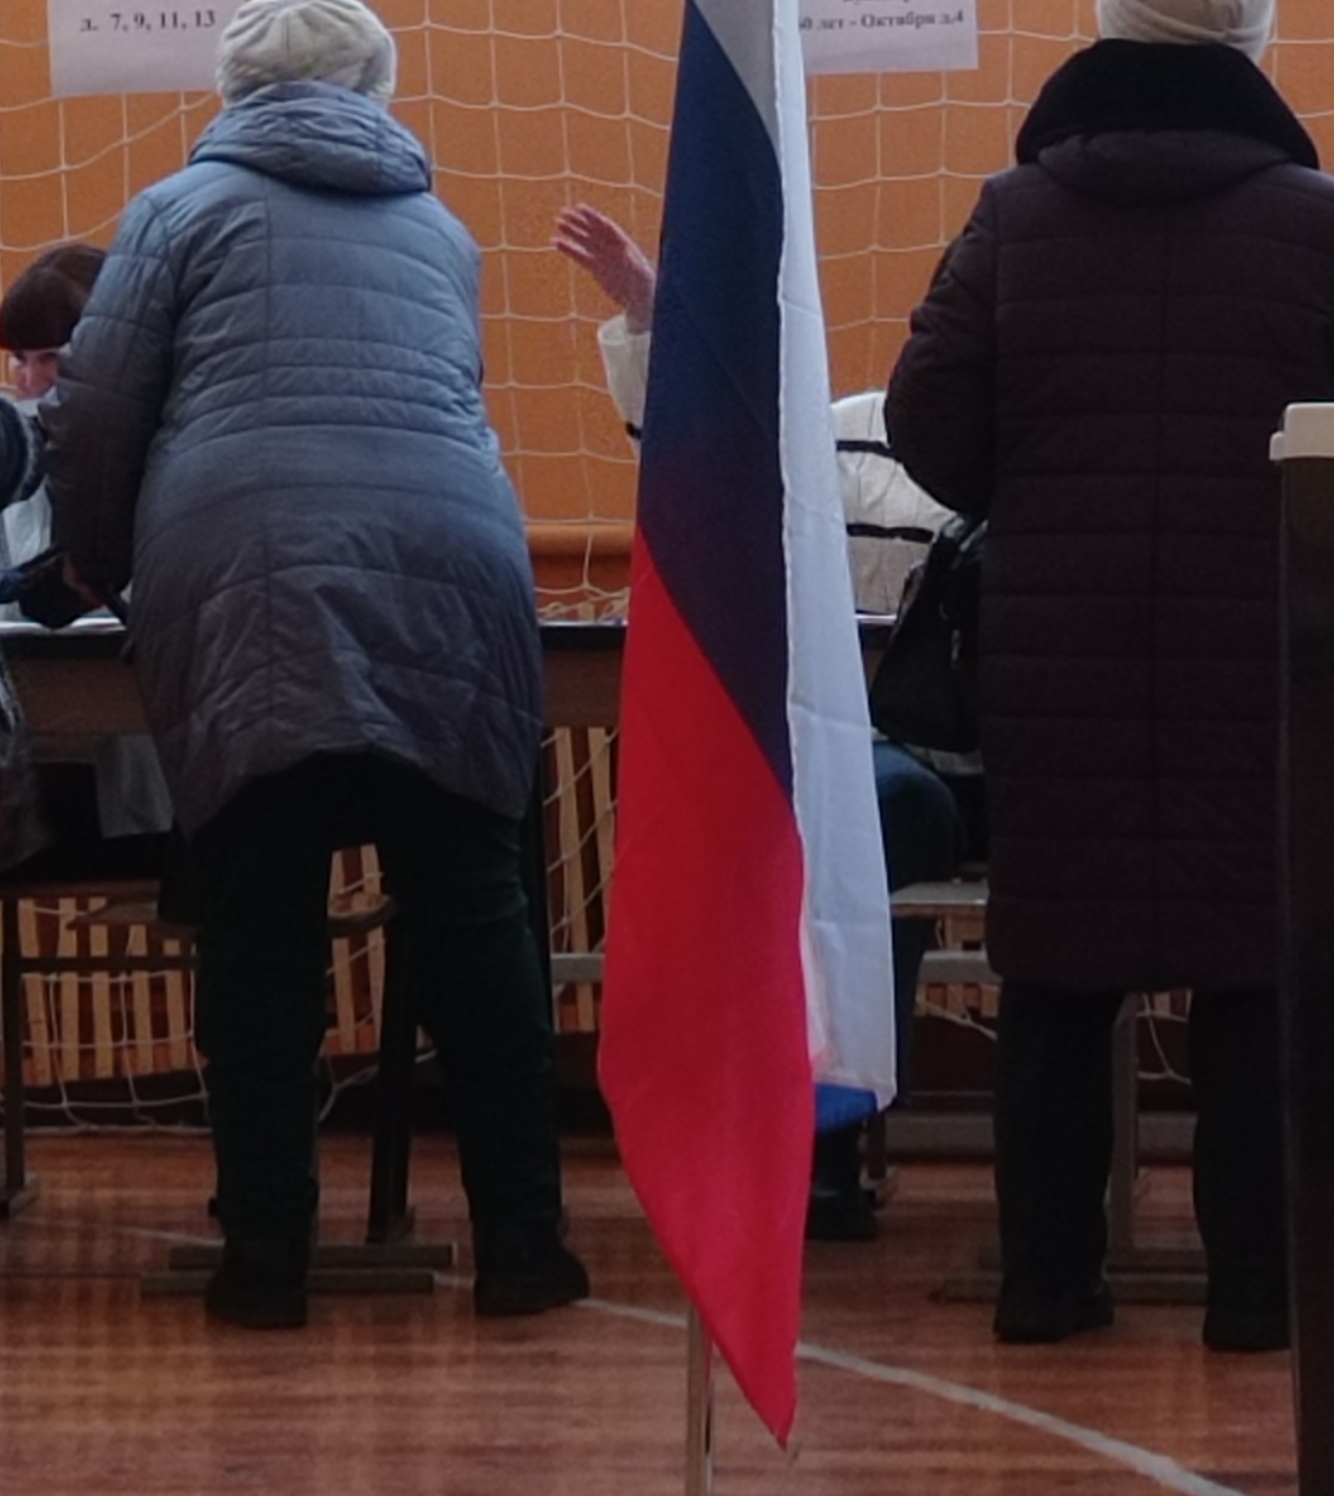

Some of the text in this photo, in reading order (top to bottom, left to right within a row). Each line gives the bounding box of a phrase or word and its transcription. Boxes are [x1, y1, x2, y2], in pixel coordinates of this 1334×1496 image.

[110, 13, 128, 31] 7,
[133, 12, 151, 31] 9,
[159, 11, 187, 30] 11,
[194, 9, 215, 27] 13
[861, 11, 935, 29] Октября
